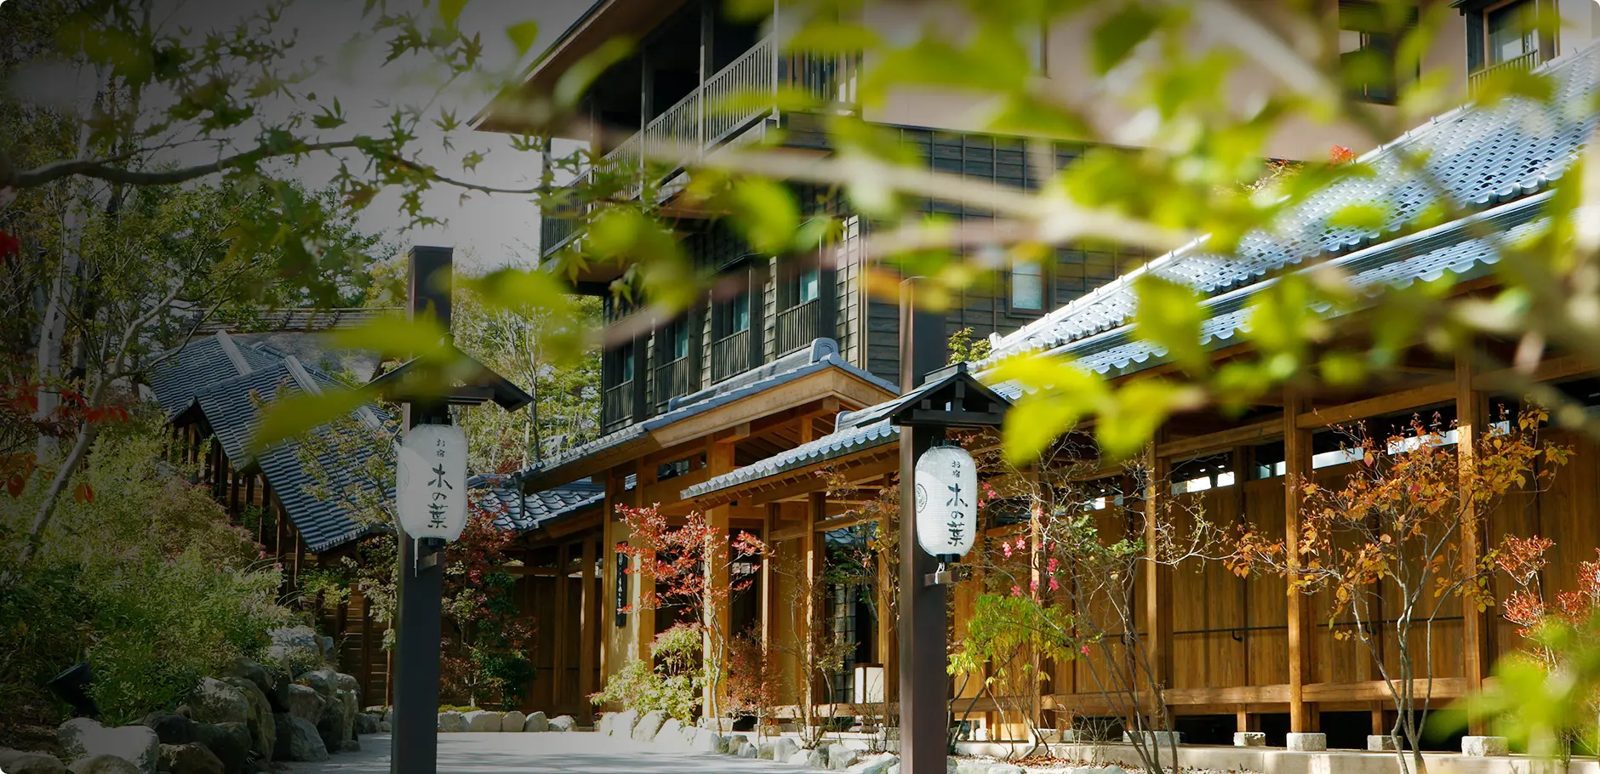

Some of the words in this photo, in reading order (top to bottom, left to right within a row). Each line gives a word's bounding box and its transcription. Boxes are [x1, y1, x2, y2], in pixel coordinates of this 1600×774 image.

[427, 463, 453, 528] 木の葉
[946, 483, 968, 546] 木の葉
